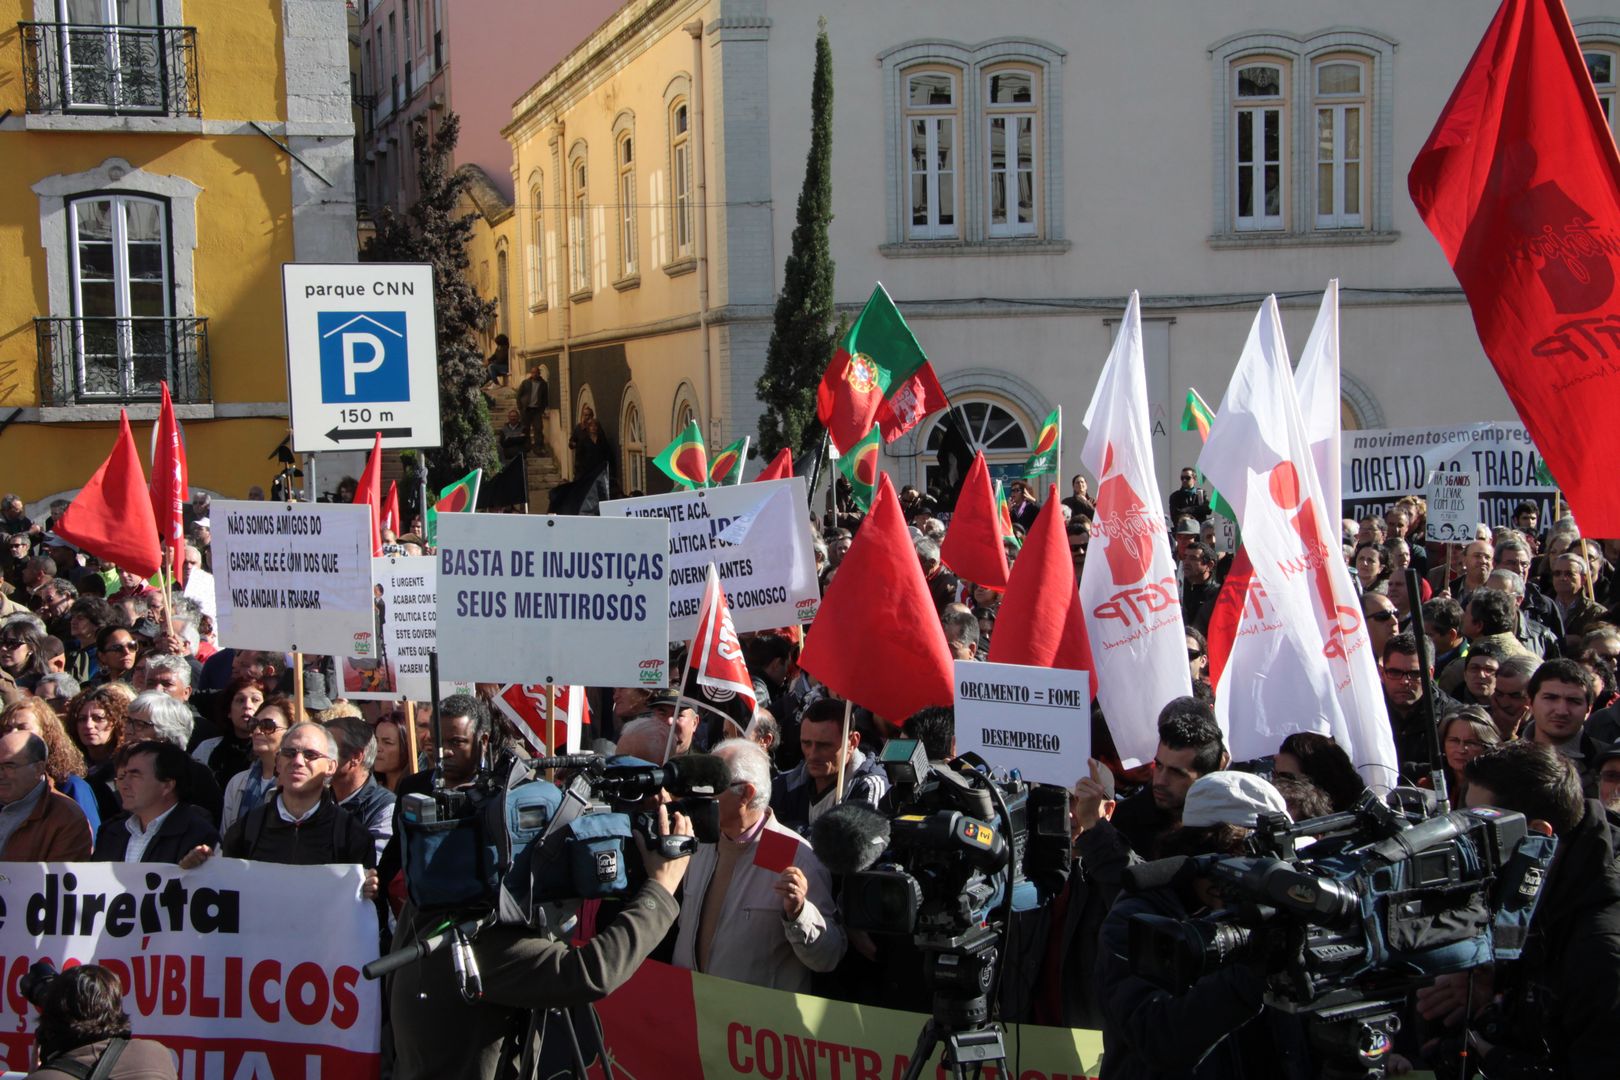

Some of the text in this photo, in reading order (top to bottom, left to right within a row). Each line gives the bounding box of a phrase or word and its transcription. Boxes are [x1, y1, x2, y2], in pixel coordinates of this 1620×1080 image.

[304, 281, 414, 299] parque CNN
[342, 332, 386, 396] P
[339, 408, 394, 423] 150 m
[1354, 426, 1532, 449] movimentosemempreg
[1351, 455, 1425, 493] DIREITO
[227, 511, 322, 536] NÃO SOMOS AMIGOS DO
[230, 551, 264, 576] GASPAR,
[263, 552, 279, 572] ELE
[279, 547, 286, 572] É
[303, 553, 320, 573] DOS
[321, 553, 339, 575] QUE
[441, 548, 664, 587] BASTA DE INJUSTIÇAS
[719, 558, 754, 580] ANTES
[396, 576, 425, 588] URGENTE
[231, 588, 322, 610] NOS ANDAM A ROUBAR
[393, 594, 417, 605] ACABAR
[417, 594, 432, 605] COM
[456, 590, 648, 622] SEUS MENTIROSOS
[736, 585, 787, 611] CONOSCO
[422, 612, 427, 621] E
[427, 611, 437, 621] CO
[396, 628, 437, 639] ESTE GOVERN
[397, 646, 417, 657] ANTES
[417, 646, 431, 657] QUE
[399, 663, 424, 674] ACABEM
[960, 680, 1030, 703] ORÇAMENTO
[1048, 688, 1081, 707] FOME
[981, 727, 1060, 751] DESEMPREGO
[979, 831, 991, 841] tvi
[26, 871, 241, 938] direita
[98, 936, 361, 1030] PÚBLICOS
